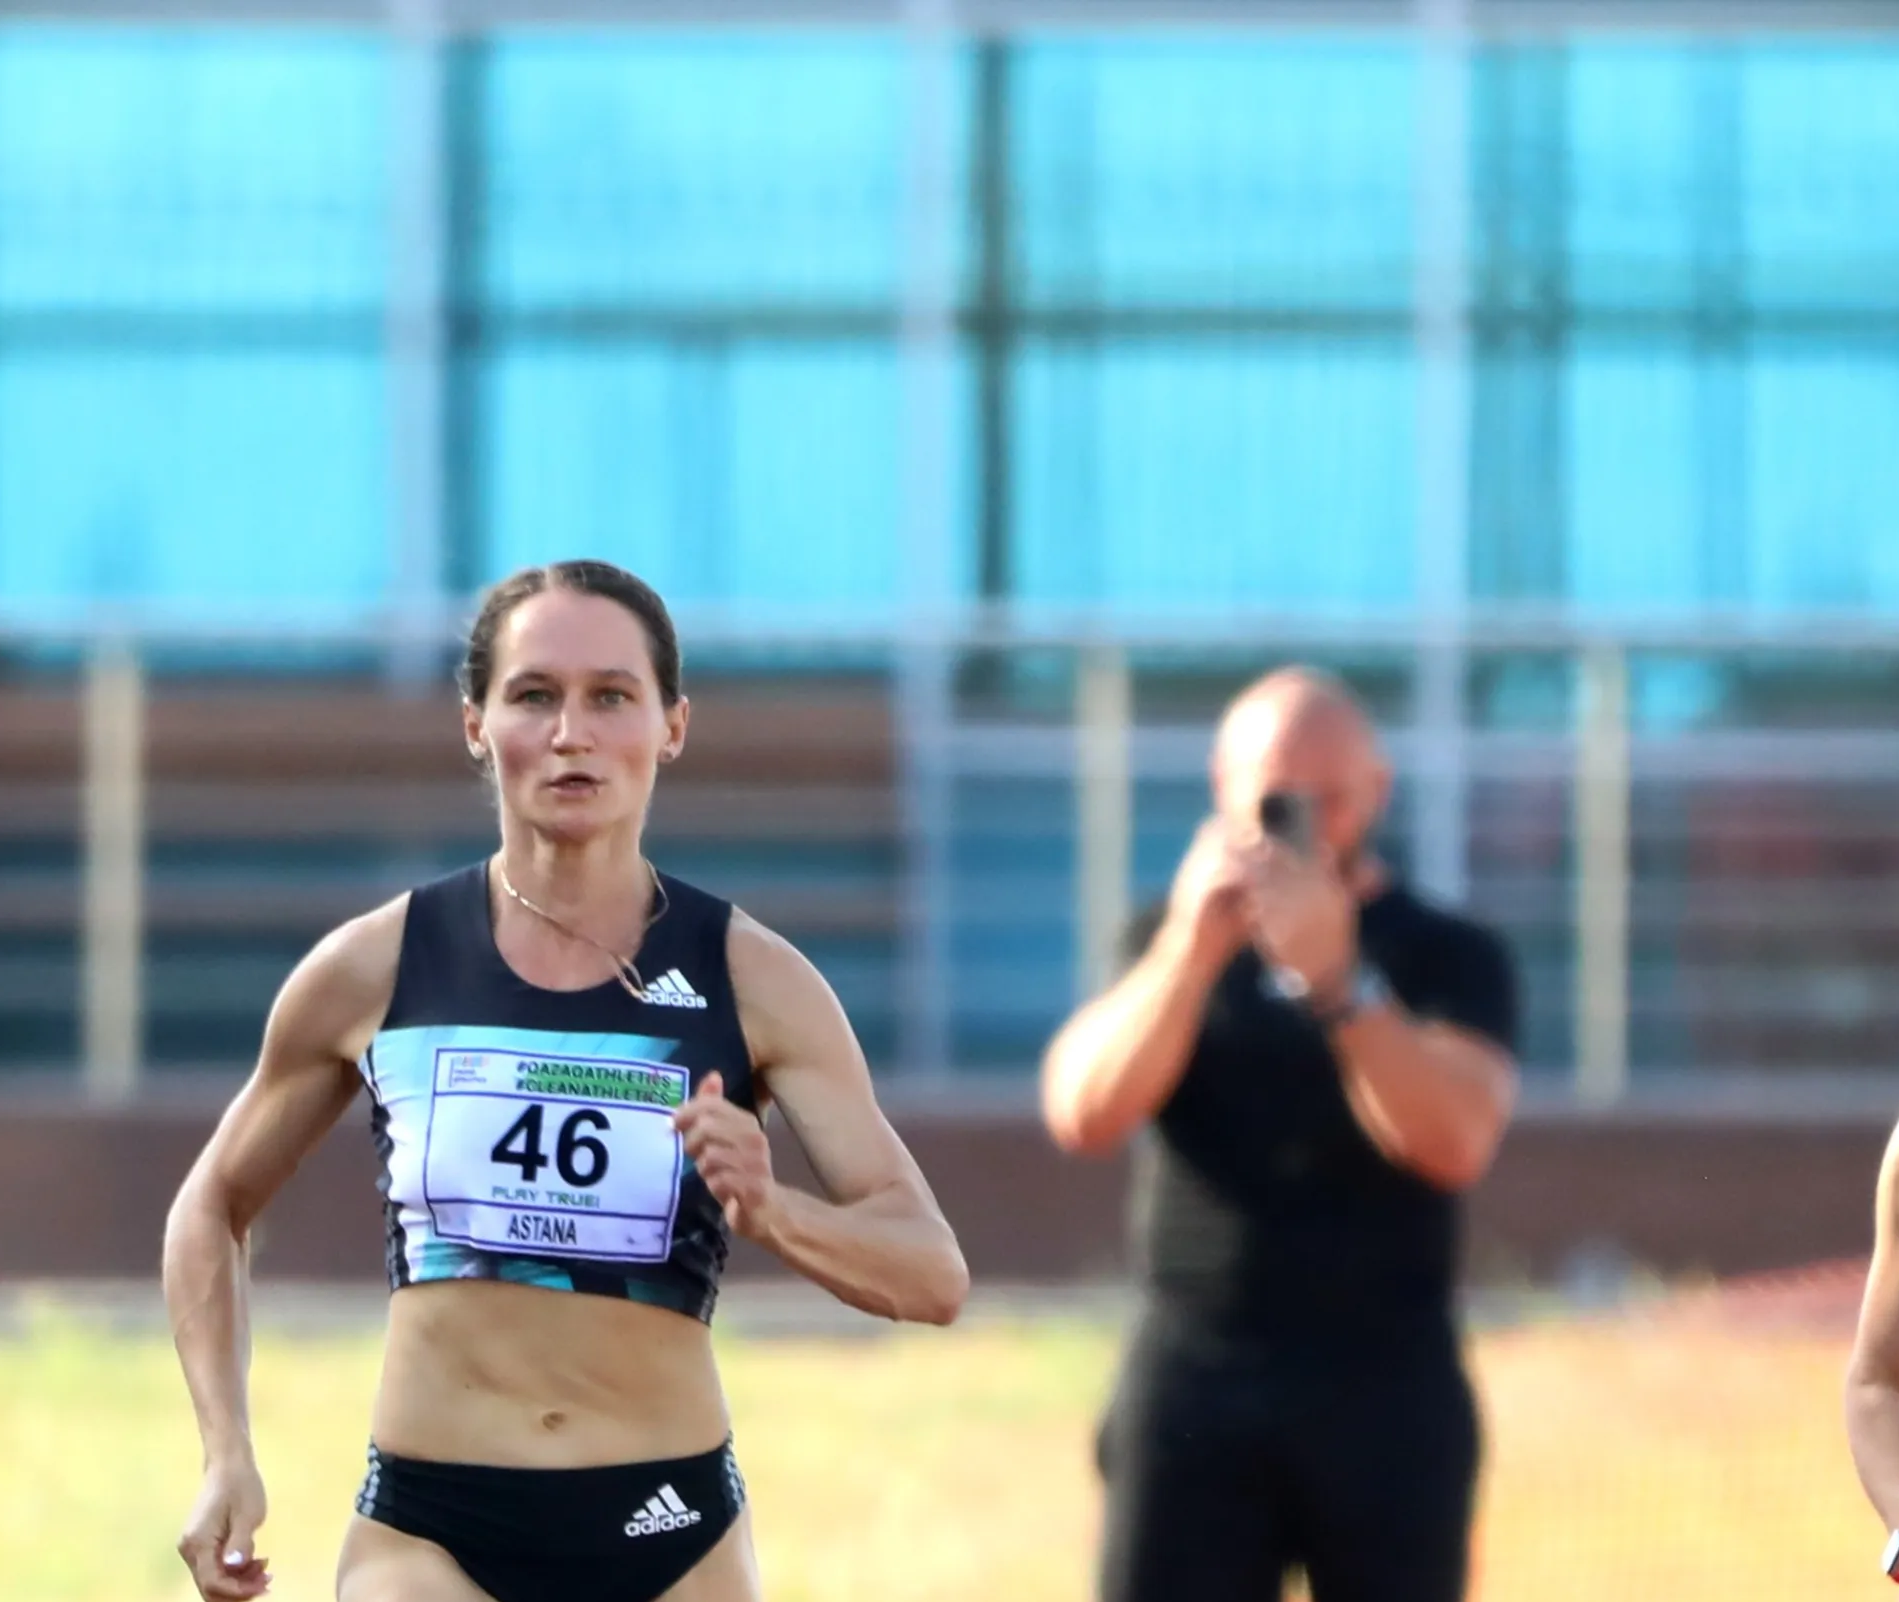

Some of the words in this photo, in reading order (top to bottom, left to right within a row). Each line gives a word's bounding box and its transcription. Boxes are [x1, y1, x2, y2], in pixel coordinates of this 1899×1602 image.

[641, 989, 708, 1009] adidas
[515, 1077, 670, 1106] #CLEANATHLETICS
[490, 1103, 612, 1188] 46
[507, 1212, 578, 1246] ASTANA
[624, 1510, 702, 1537] adidas
